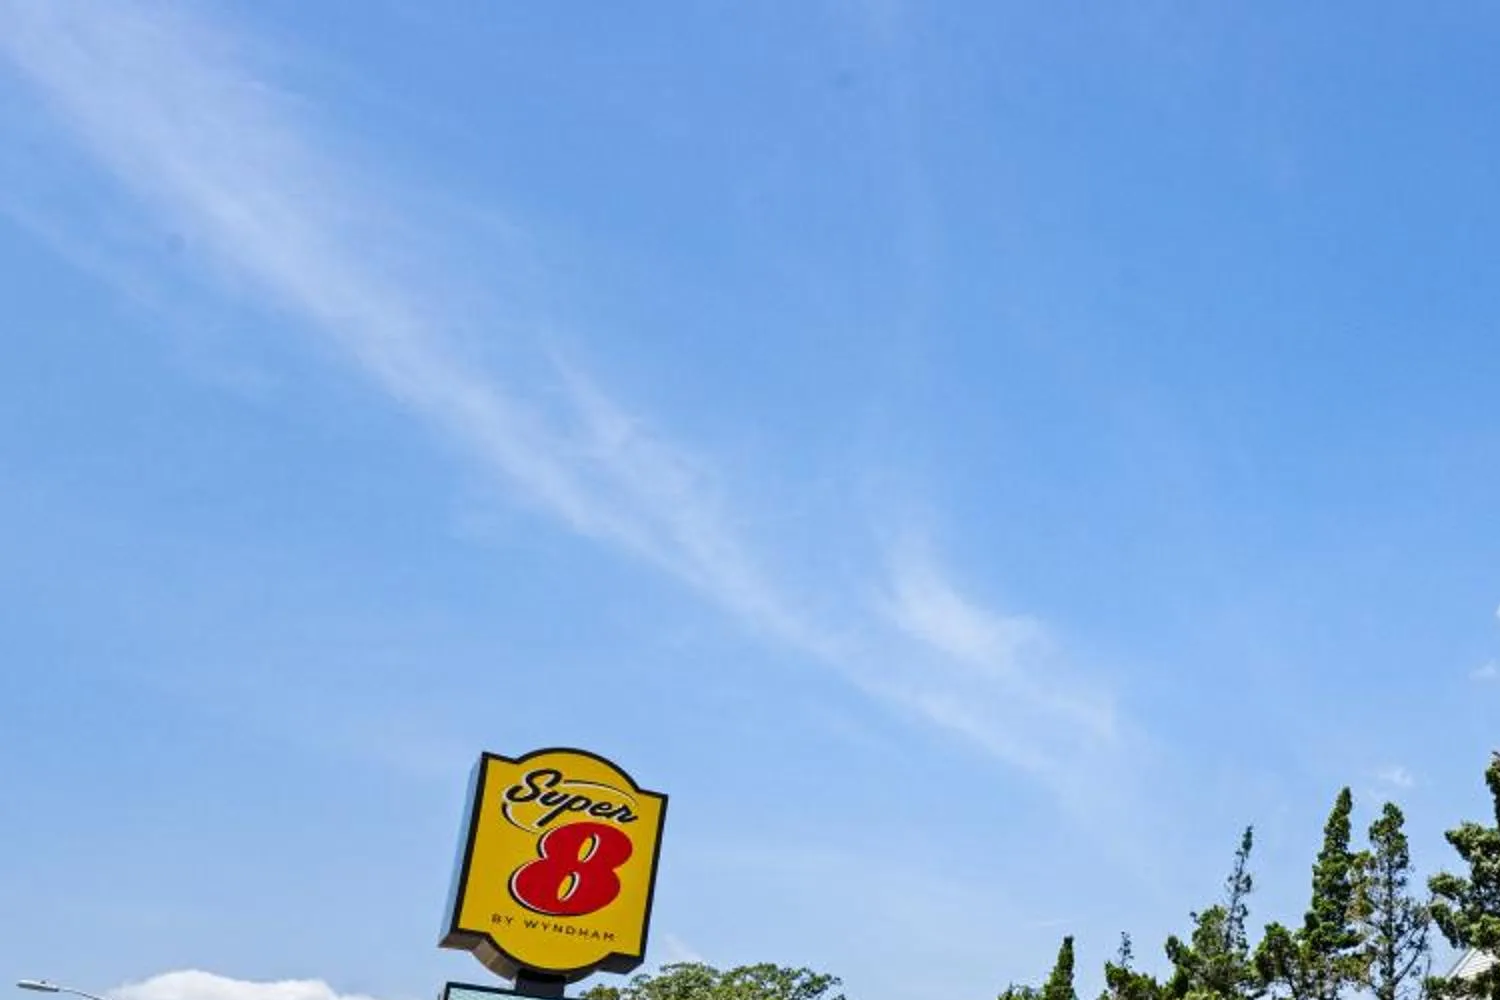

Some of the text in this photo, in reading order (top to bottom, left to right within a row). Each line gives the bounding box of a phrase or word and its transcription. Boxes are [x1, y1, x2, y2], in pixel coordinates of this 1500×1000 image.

[506, 768, 638, 828] Super
[508, 822, 633, 916] 8
[491, 914, 617, 942] BY WYNDHAM
